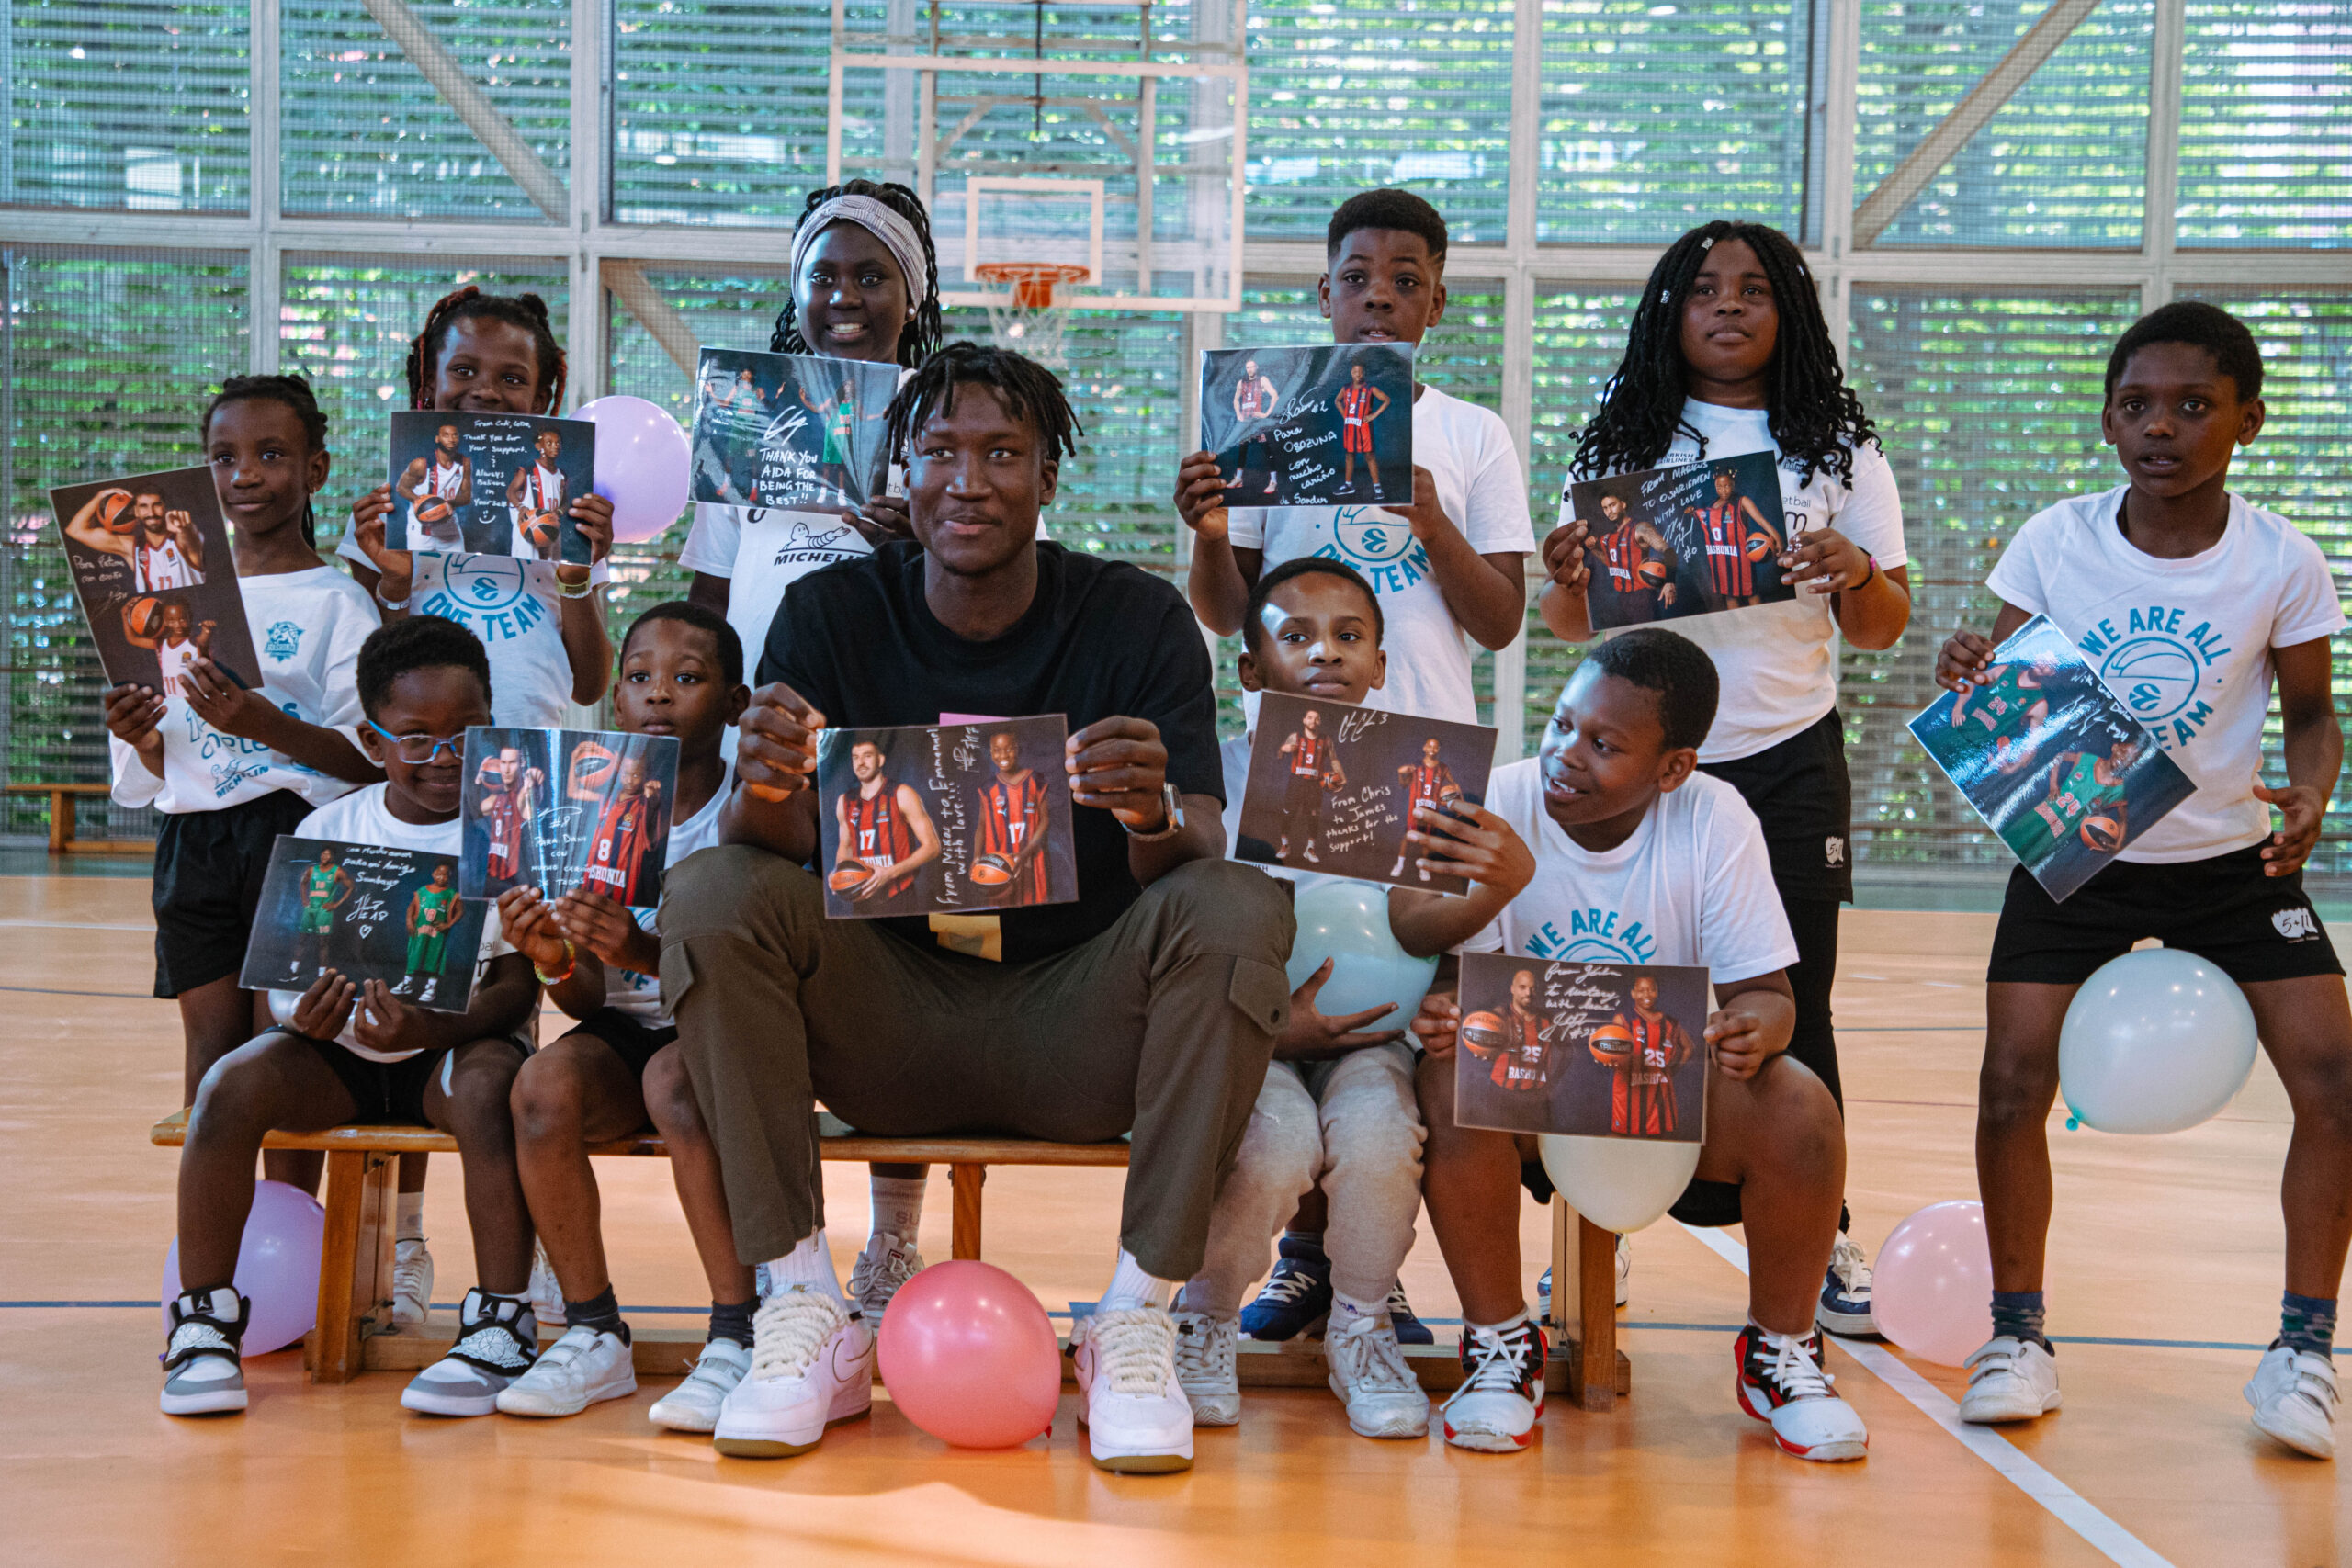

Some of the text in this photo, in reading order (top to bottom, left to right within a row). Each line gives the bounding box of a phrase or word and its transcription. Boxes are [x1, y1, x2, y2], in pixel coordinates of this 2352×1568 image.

[1349, 404, 1356, 414] 2
[1273, 428, 1303, 441] Para
[759, 447, 797, 464] THANK
[1288, 458, 1310, 471] con
[761, 464, 817, 479] AIDA FOR
[1288, 464, 1322, 482] mucho
[1672, 461, 1709, 479] MARKUS
[759, 480, 816, 492] BEING THE
[1643, 499, 1656, 511] TO
[1654, 489, 1703, 525] WITH LOVE
[1712, 527, 1722, 542] 0
[1610, 548, 1618, 563] 0
[1369, 544, 1430, 594] TEAM
[481, 593, 546, 642] TEAM
[2078, 606, 2232, 667] WE ARE ALL
[1987, 696, 2008, 716] 24
[2152, 699, 2214, 750] EAM
[1306, 753, 1314, 765] 3
[1331, 785, 1392, 809] From Chris
[1423, 784, 1431, 796] 3
[940, 798, 953, 819] to
[1332, 802, 1387, 825] to James
[2056, 791, 2082, 818] 24
[1385, 814, 1399, 825] the
[859, 829, 876, 850] 17
[1008, 822, 1026, 845] 17
[598, 838, 611, 862] 8
[1525, 921, 1566, 959] WE
[1571, 908, 1619, 938] ARE
[1521, 1045, 1543, 1063] 25
[1644, 1048, 1667, 1068] 25
